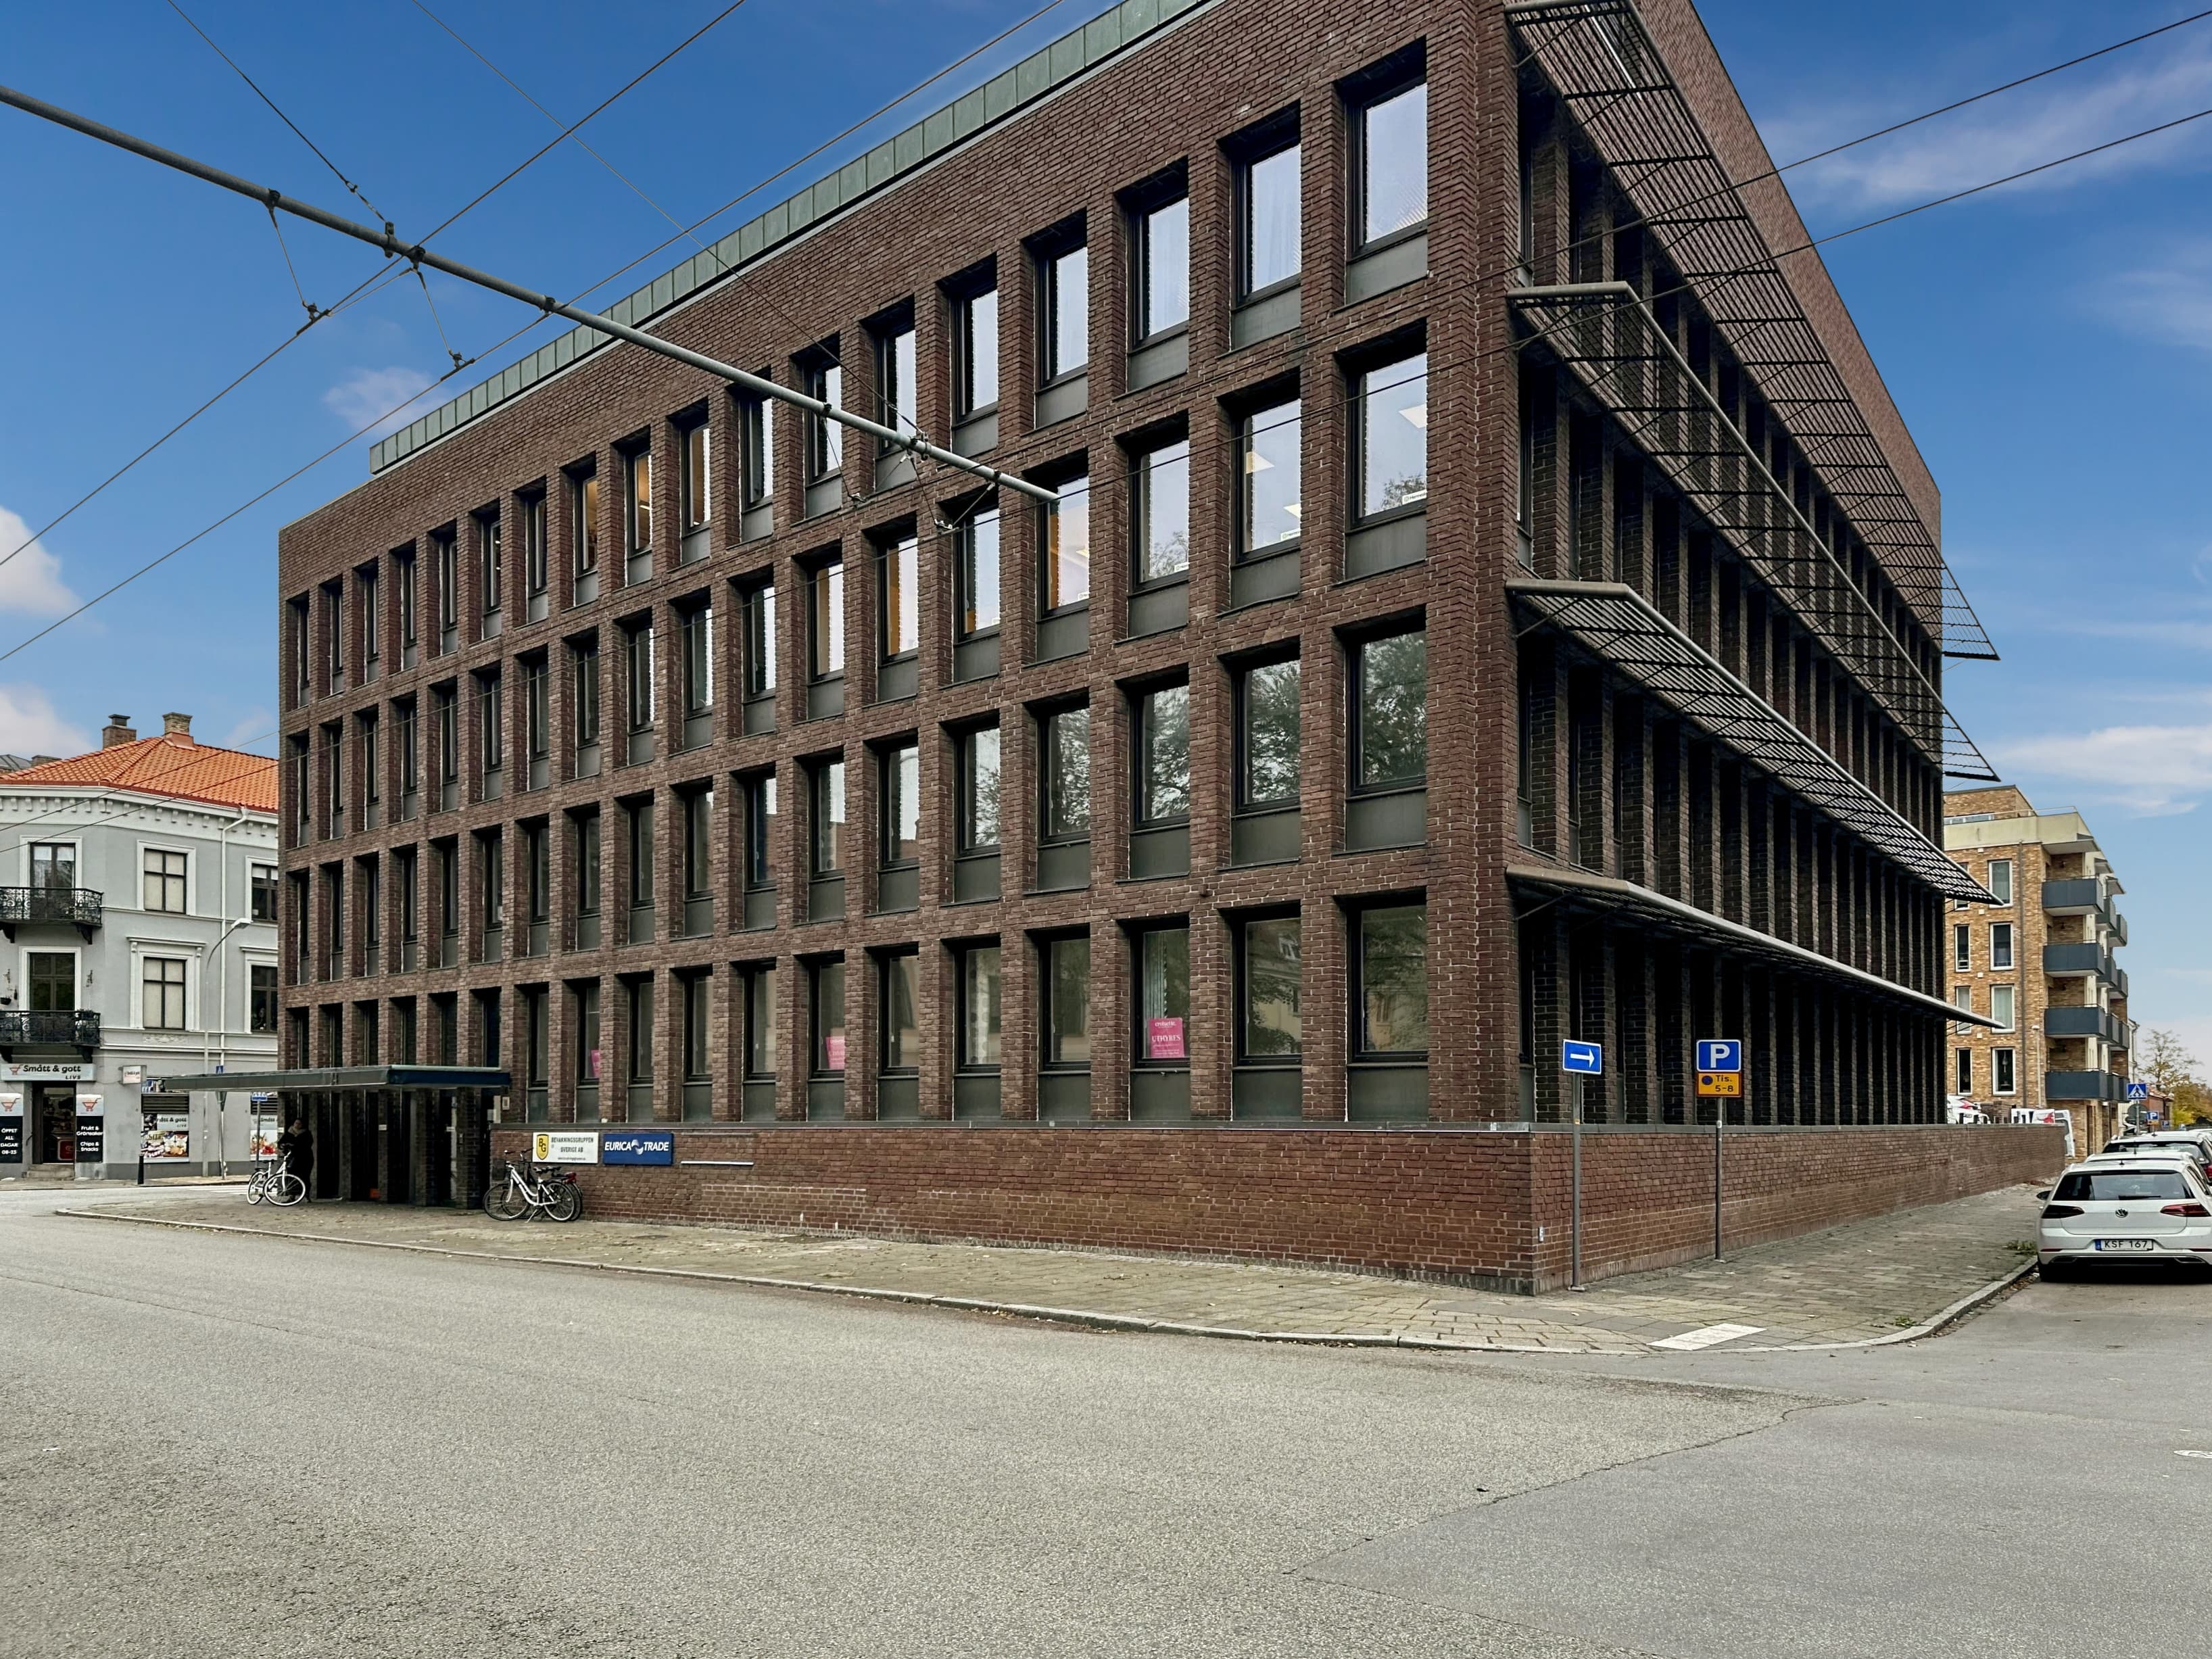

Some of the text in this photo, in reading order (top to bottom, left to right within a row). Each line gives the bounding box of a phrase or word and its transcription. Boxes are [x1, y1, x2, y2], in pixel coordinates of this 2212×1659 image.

[1710, 1044, 1730, 1068] P
[62, 1065, 81, 1074] gott
[604, 1141, 669, 1151] EURICA TRADE
[2105, 1240, 2123, 1248] KSF
[2129, 1240, 2148, 1248] 167
